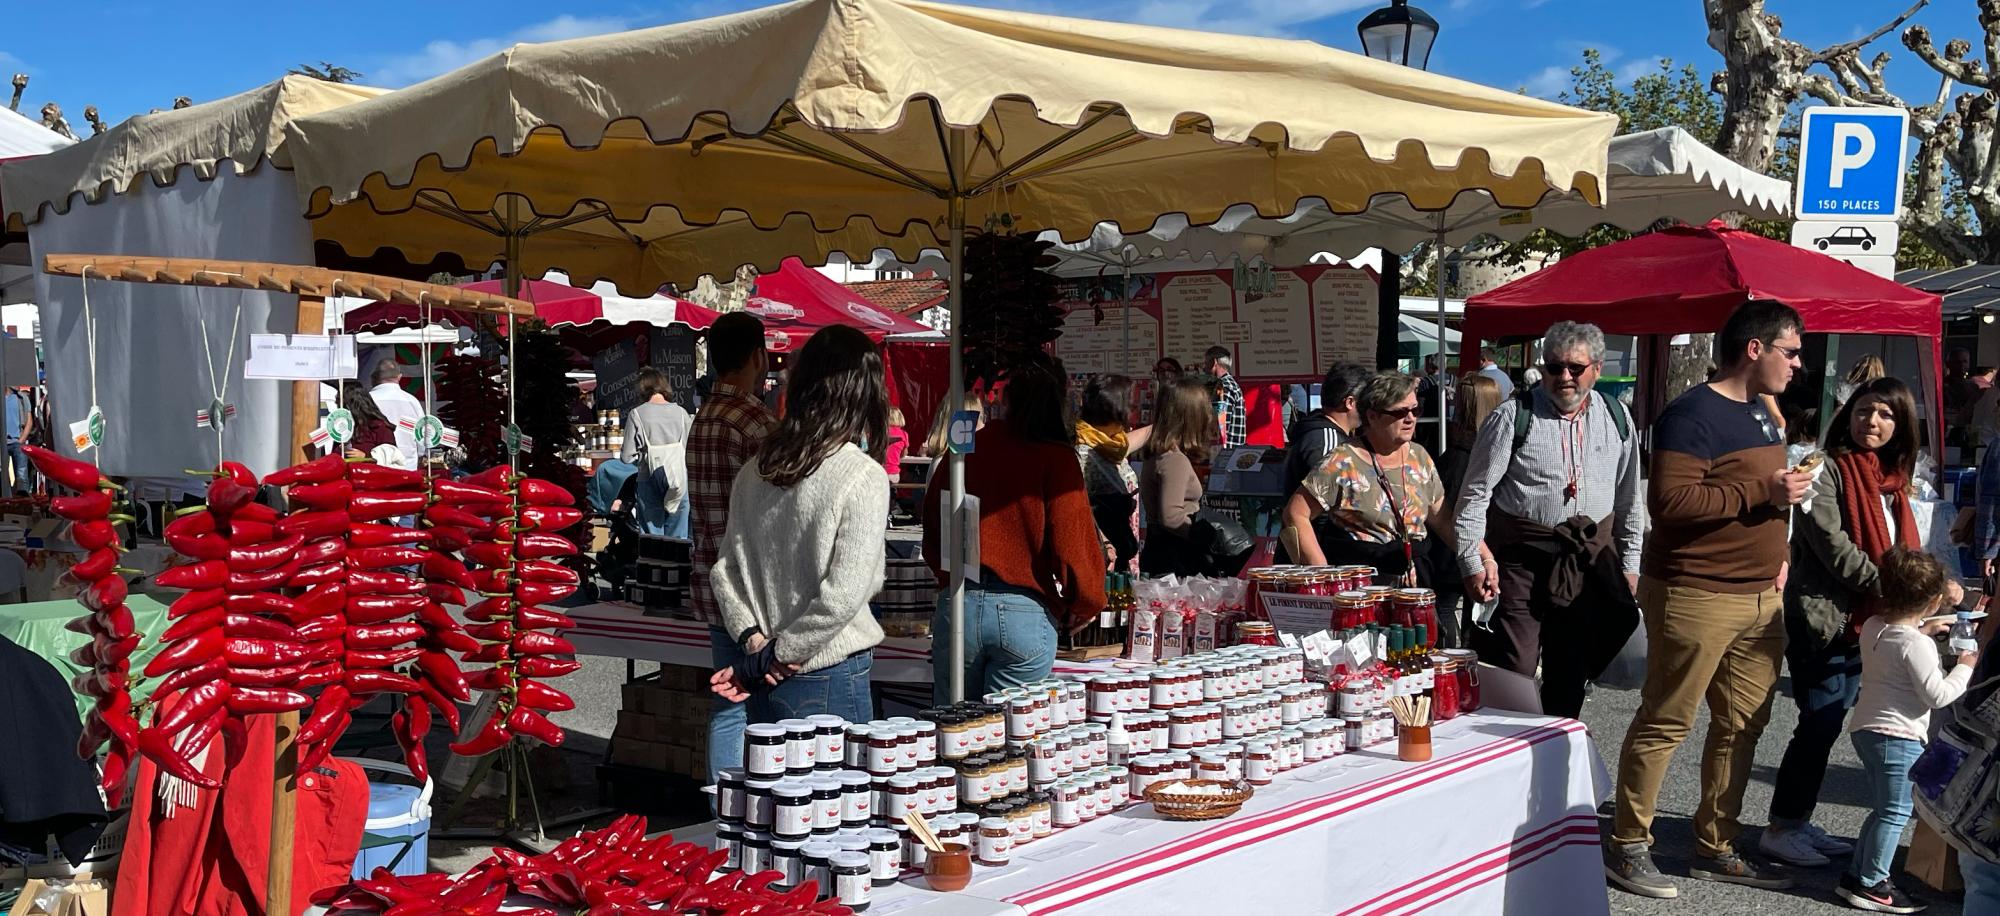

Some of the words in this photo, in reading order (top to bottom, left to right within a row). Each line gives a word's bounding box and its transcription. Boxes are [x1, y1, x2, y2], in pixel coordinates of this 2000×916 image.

[1829, 122, 1876, 189] P
[1818, 199, 1837, 210] 150
[1843, 200, 1880, 210] PLACES
[663, 348, 692, 364] Maison
[600, 370, 640, 397] Conserves
[667, 366, 693, 389] Foie
[1268, 597, 1277, 606] LE
[1277, 598, 1298, 608] PIMENT
